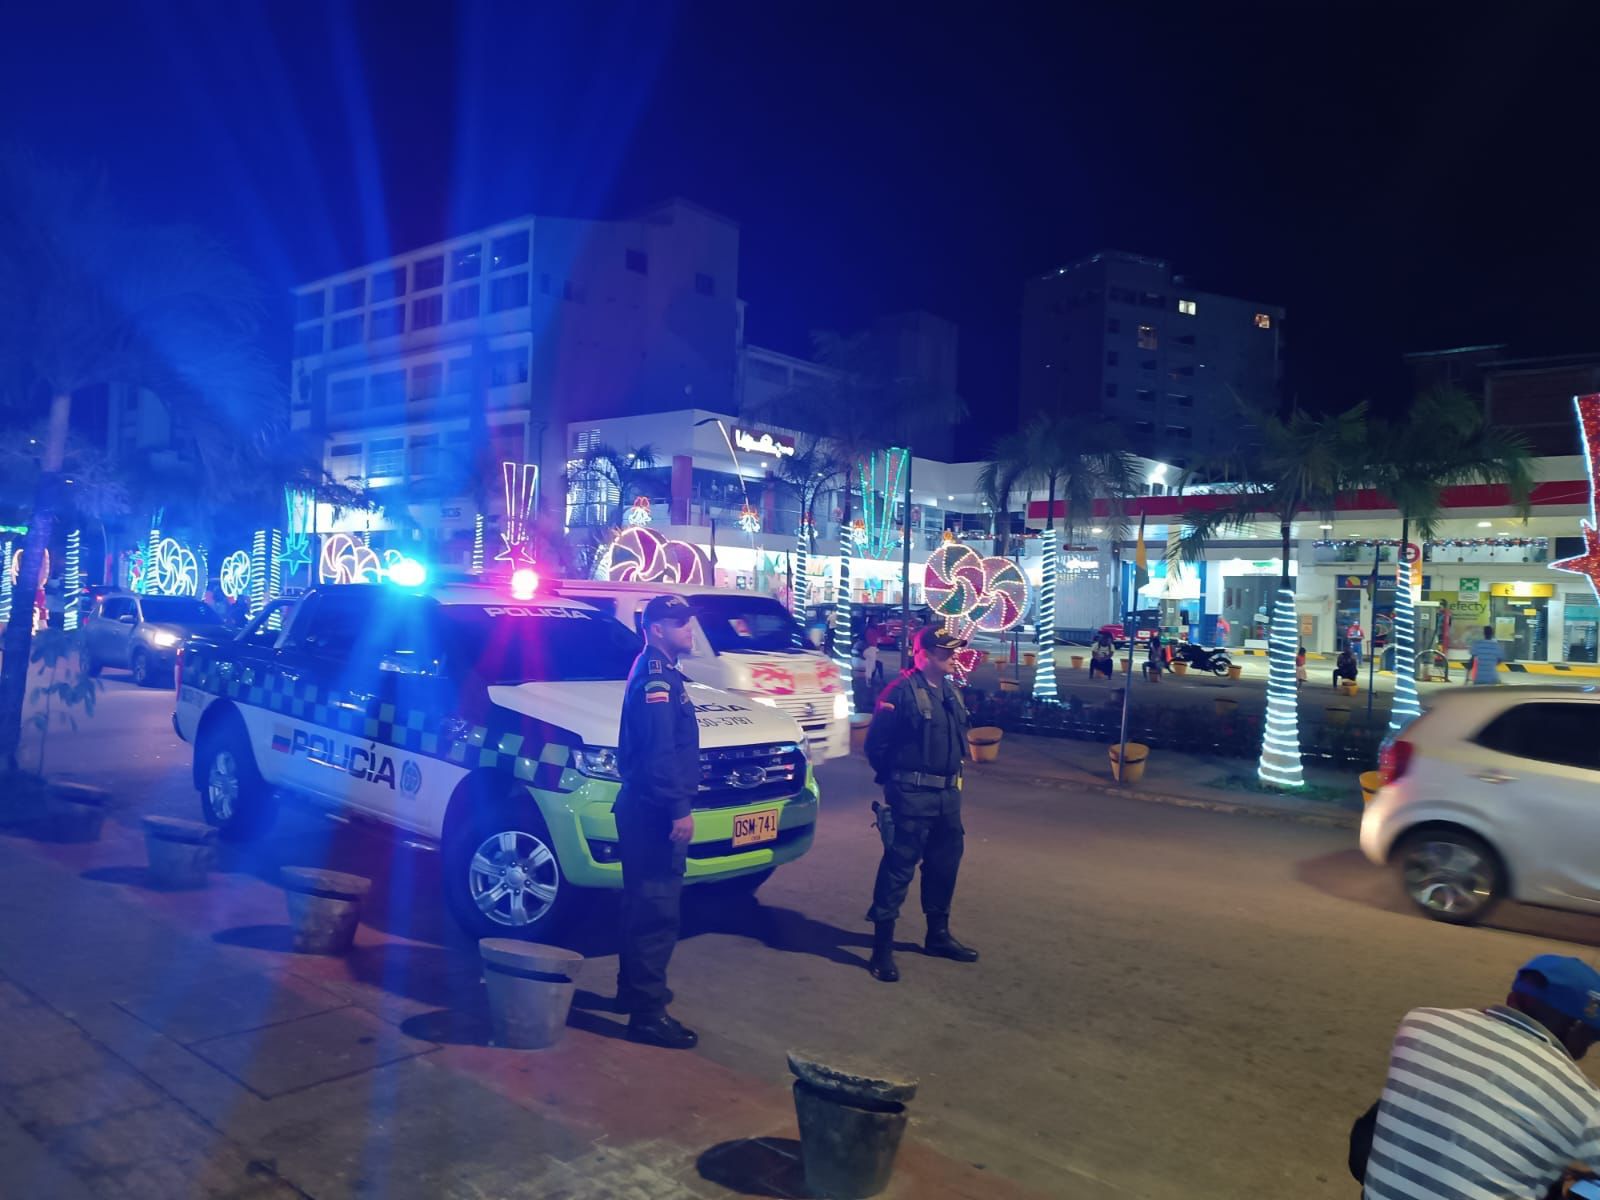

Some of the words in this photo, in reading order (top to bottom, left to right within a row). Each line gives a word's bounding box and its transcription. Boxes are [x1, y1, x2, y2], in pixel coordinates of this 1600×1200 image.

[1450, 601, 1487, 613] efecty
[290, 729, 396, 790] POLICÍA
[758, 815, 776, 833] 741
